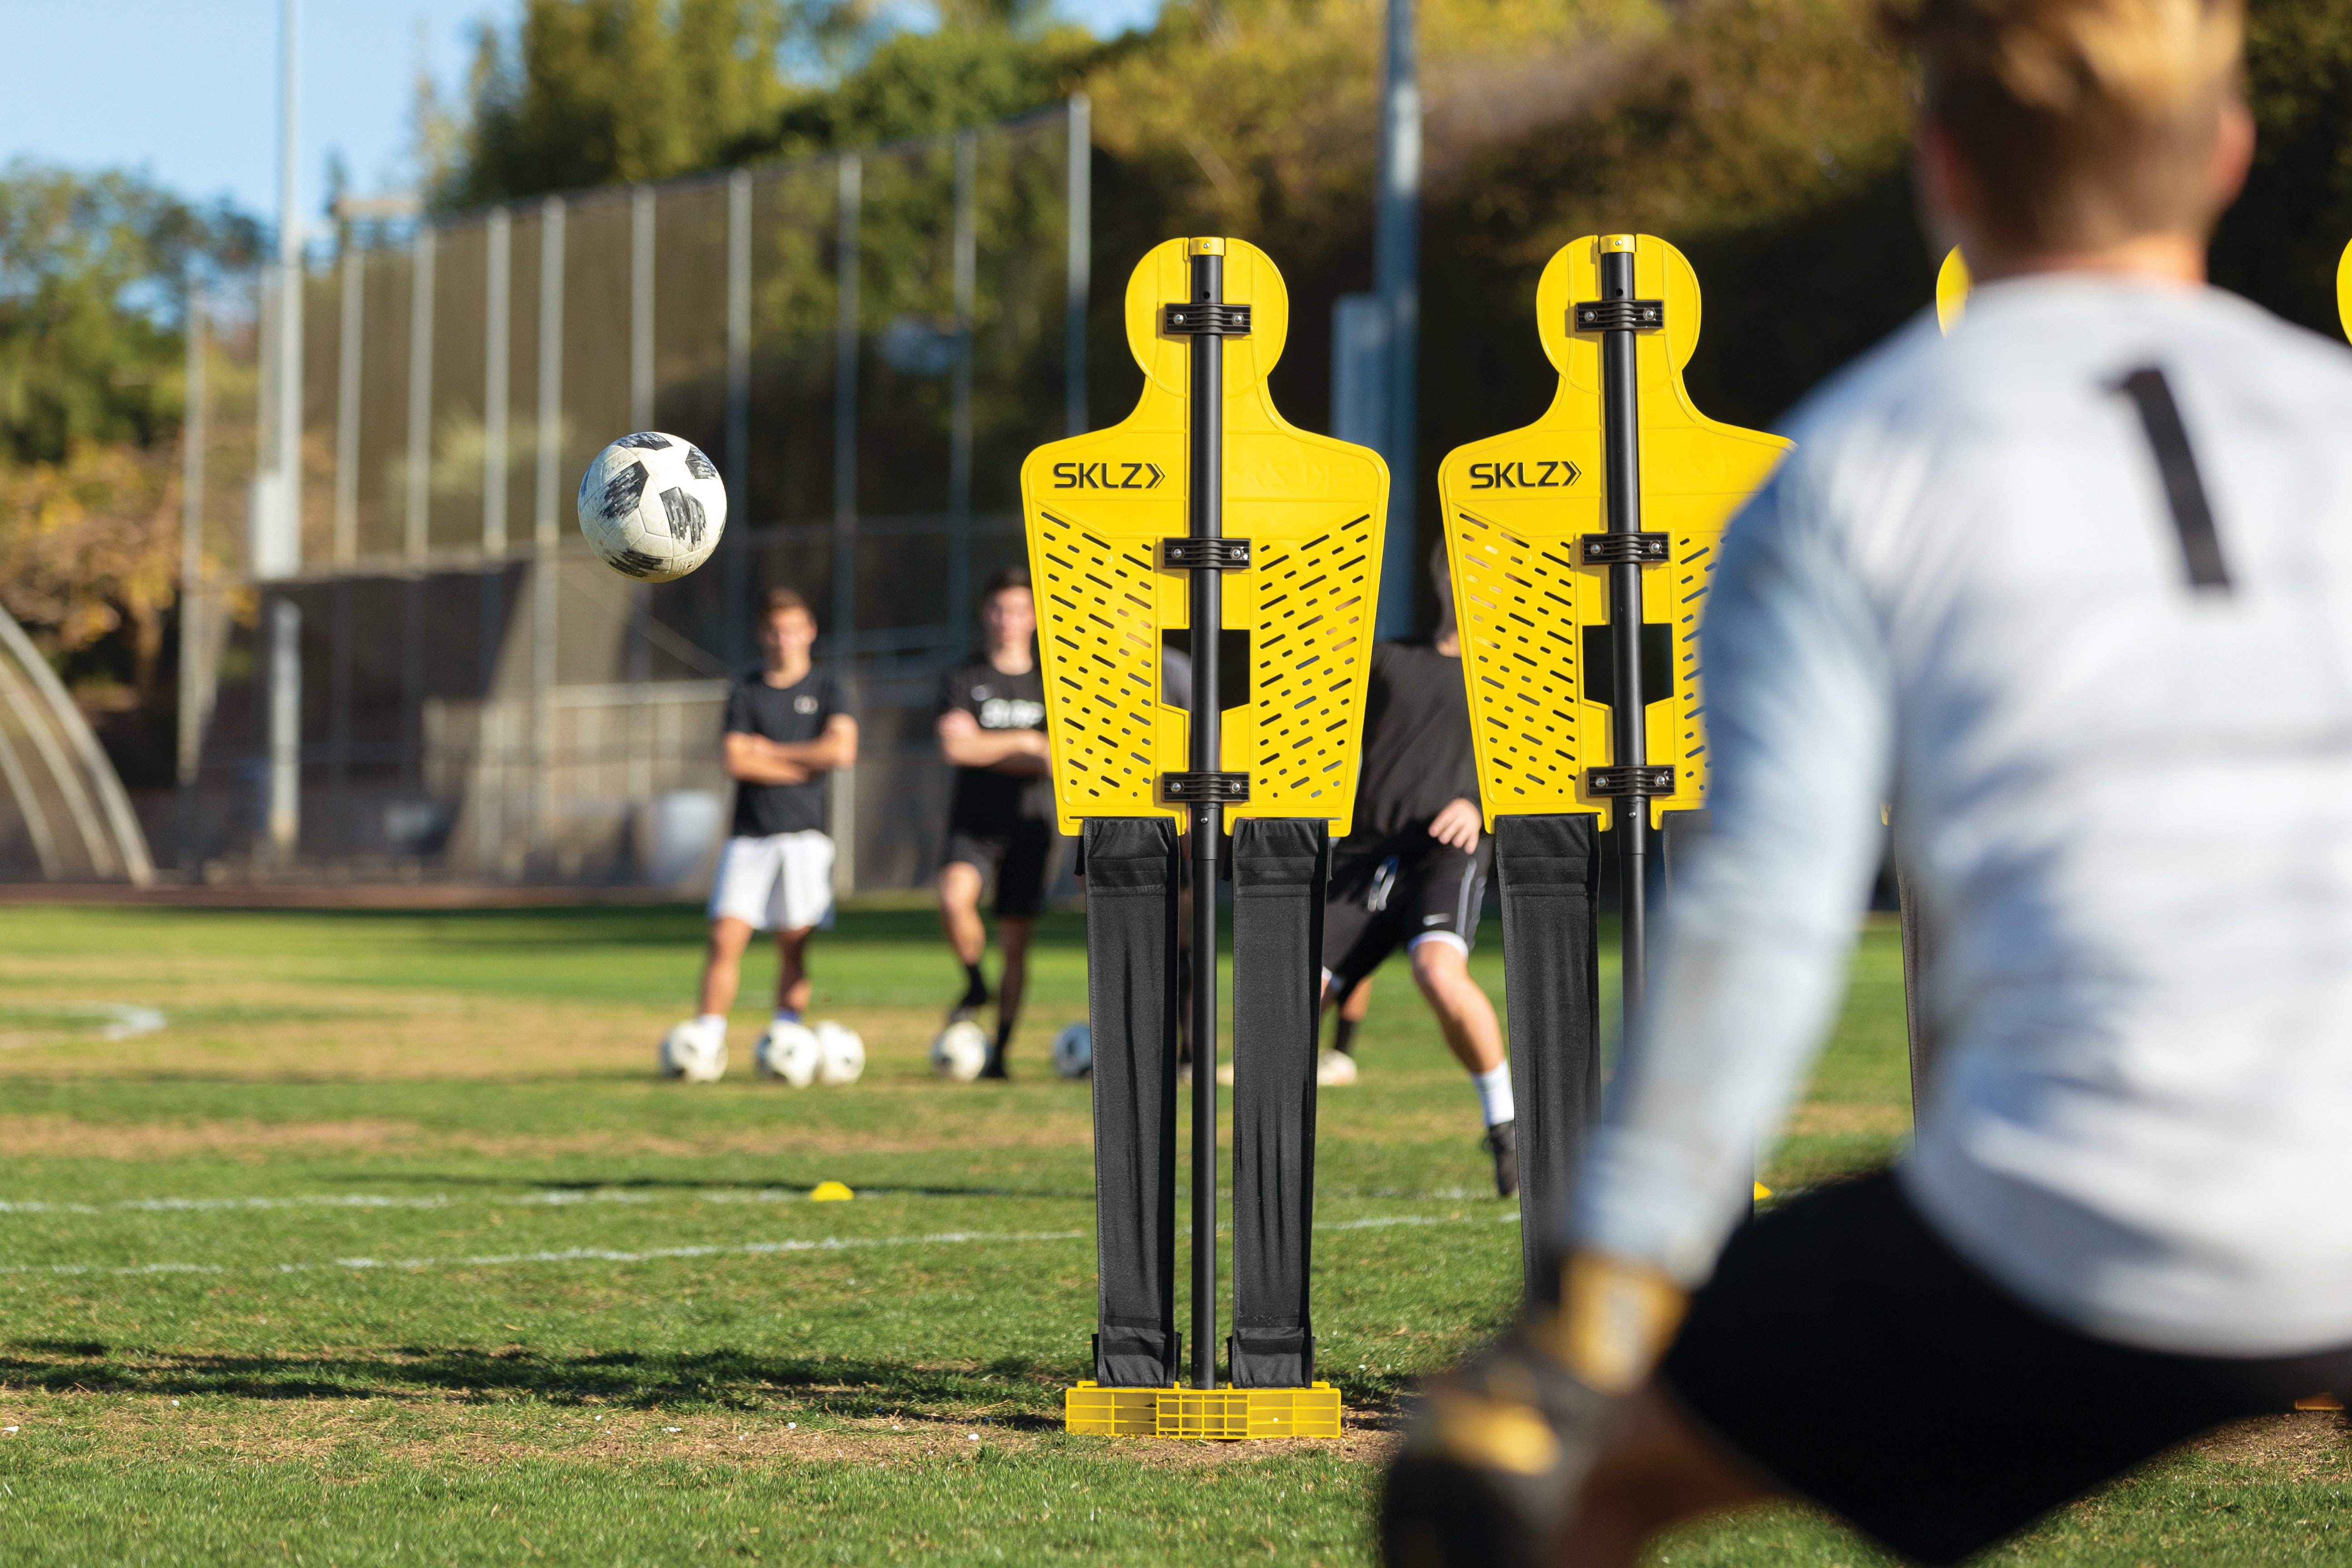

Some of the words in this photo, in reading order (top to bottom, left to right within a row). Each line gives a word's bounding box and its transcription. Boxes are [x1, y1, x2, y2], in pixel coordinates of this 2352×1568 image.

[1053, 462, 1142, 489] SKLZ
[1469, 461, 1560, 489] SKLZ
[2095, 366, 2232, 592] 1
